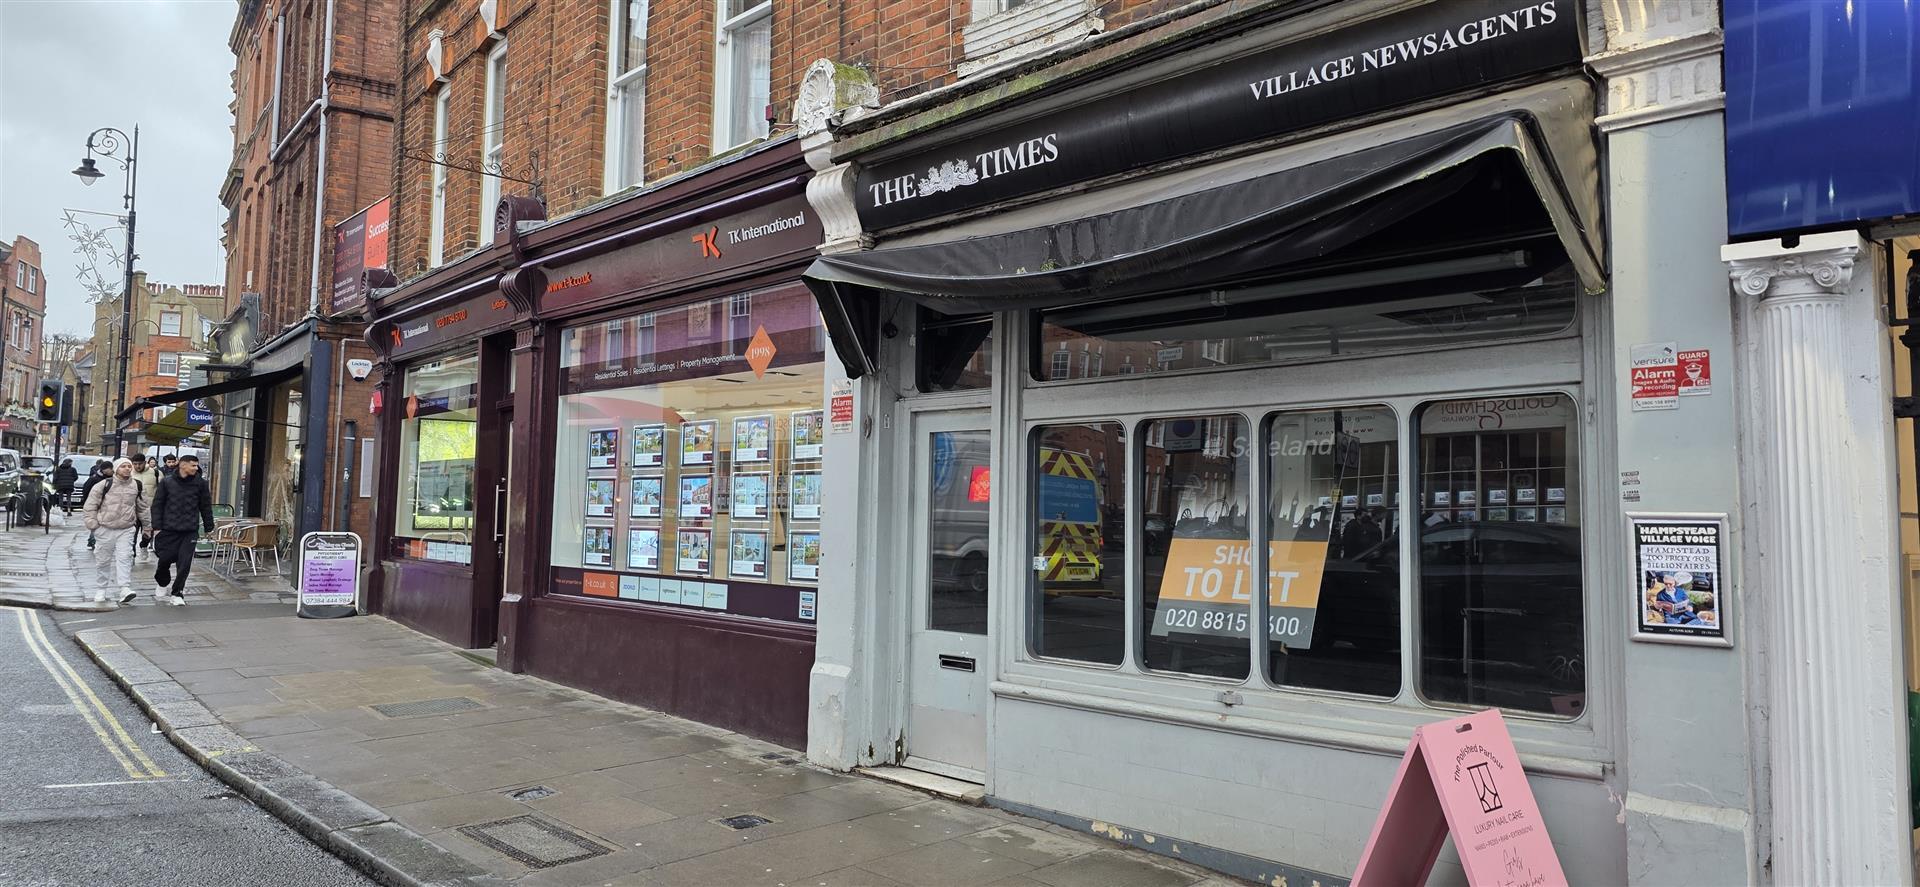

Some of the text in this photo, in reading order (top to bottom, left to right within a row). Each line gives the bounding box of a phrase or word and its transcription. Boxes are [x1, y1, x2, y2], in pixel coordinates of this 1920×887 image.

[1249, 2, 1557, 101] VILLAGE NEWSAGENTS
[869, 133, 1059, 208] THE TIMES
[368, 219, 390, 239] Succes
[728, 211, 805, 244] TK International
[751, 346, 770, 360] 1998
[1633, 356, 1675, 366] verisure
[1679, 351, 1708, 360] GUARD
[594, 353, 736, 380] Residential Sales Residential Lettings Property Management
[1633, 369, 1676, 379] Alarm
[1230, 434, 1335, 458] Seland
[1640, 526, 1717, 535] HAMPSTEAD
[1640, 535, 1716, 544] VILLAGE VOICE
[1646, 547, 1710, 555] HAMPSTEAD
[1647, 562, 1711, 570] BILLIONAIRES
[1184, 567, 1300, 603] TO LT
[1165, 608, 1198, 628] 020
[1202, 611, 1248, 632] 8815
[1456, 744, 1478, 765] Polished
[1479, 745, 1504, 770] Parlour
[1474, 809, 1525, 835] LUXURY NAIL CARE
